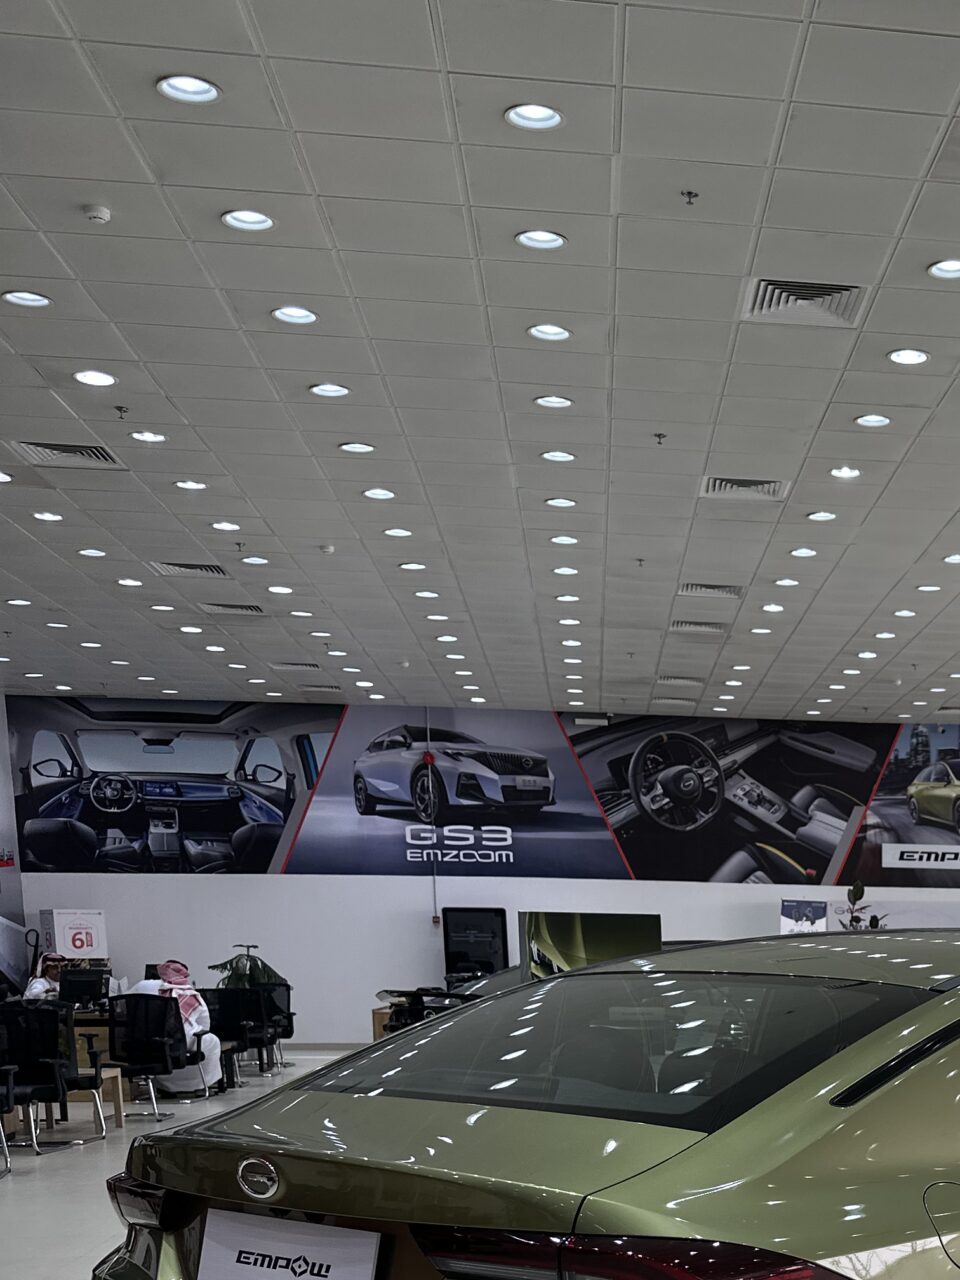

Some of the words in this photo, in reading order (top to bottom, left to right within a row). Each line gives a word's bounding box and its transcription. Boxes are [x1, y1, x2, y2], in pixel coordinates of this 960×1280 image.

[405, 825, 513, 846] GS3
[406, 849, 514, 863] EMZOOM
[71, 931, 85, 949] 6
[235, 1249, 331, 1279] EMPOW
